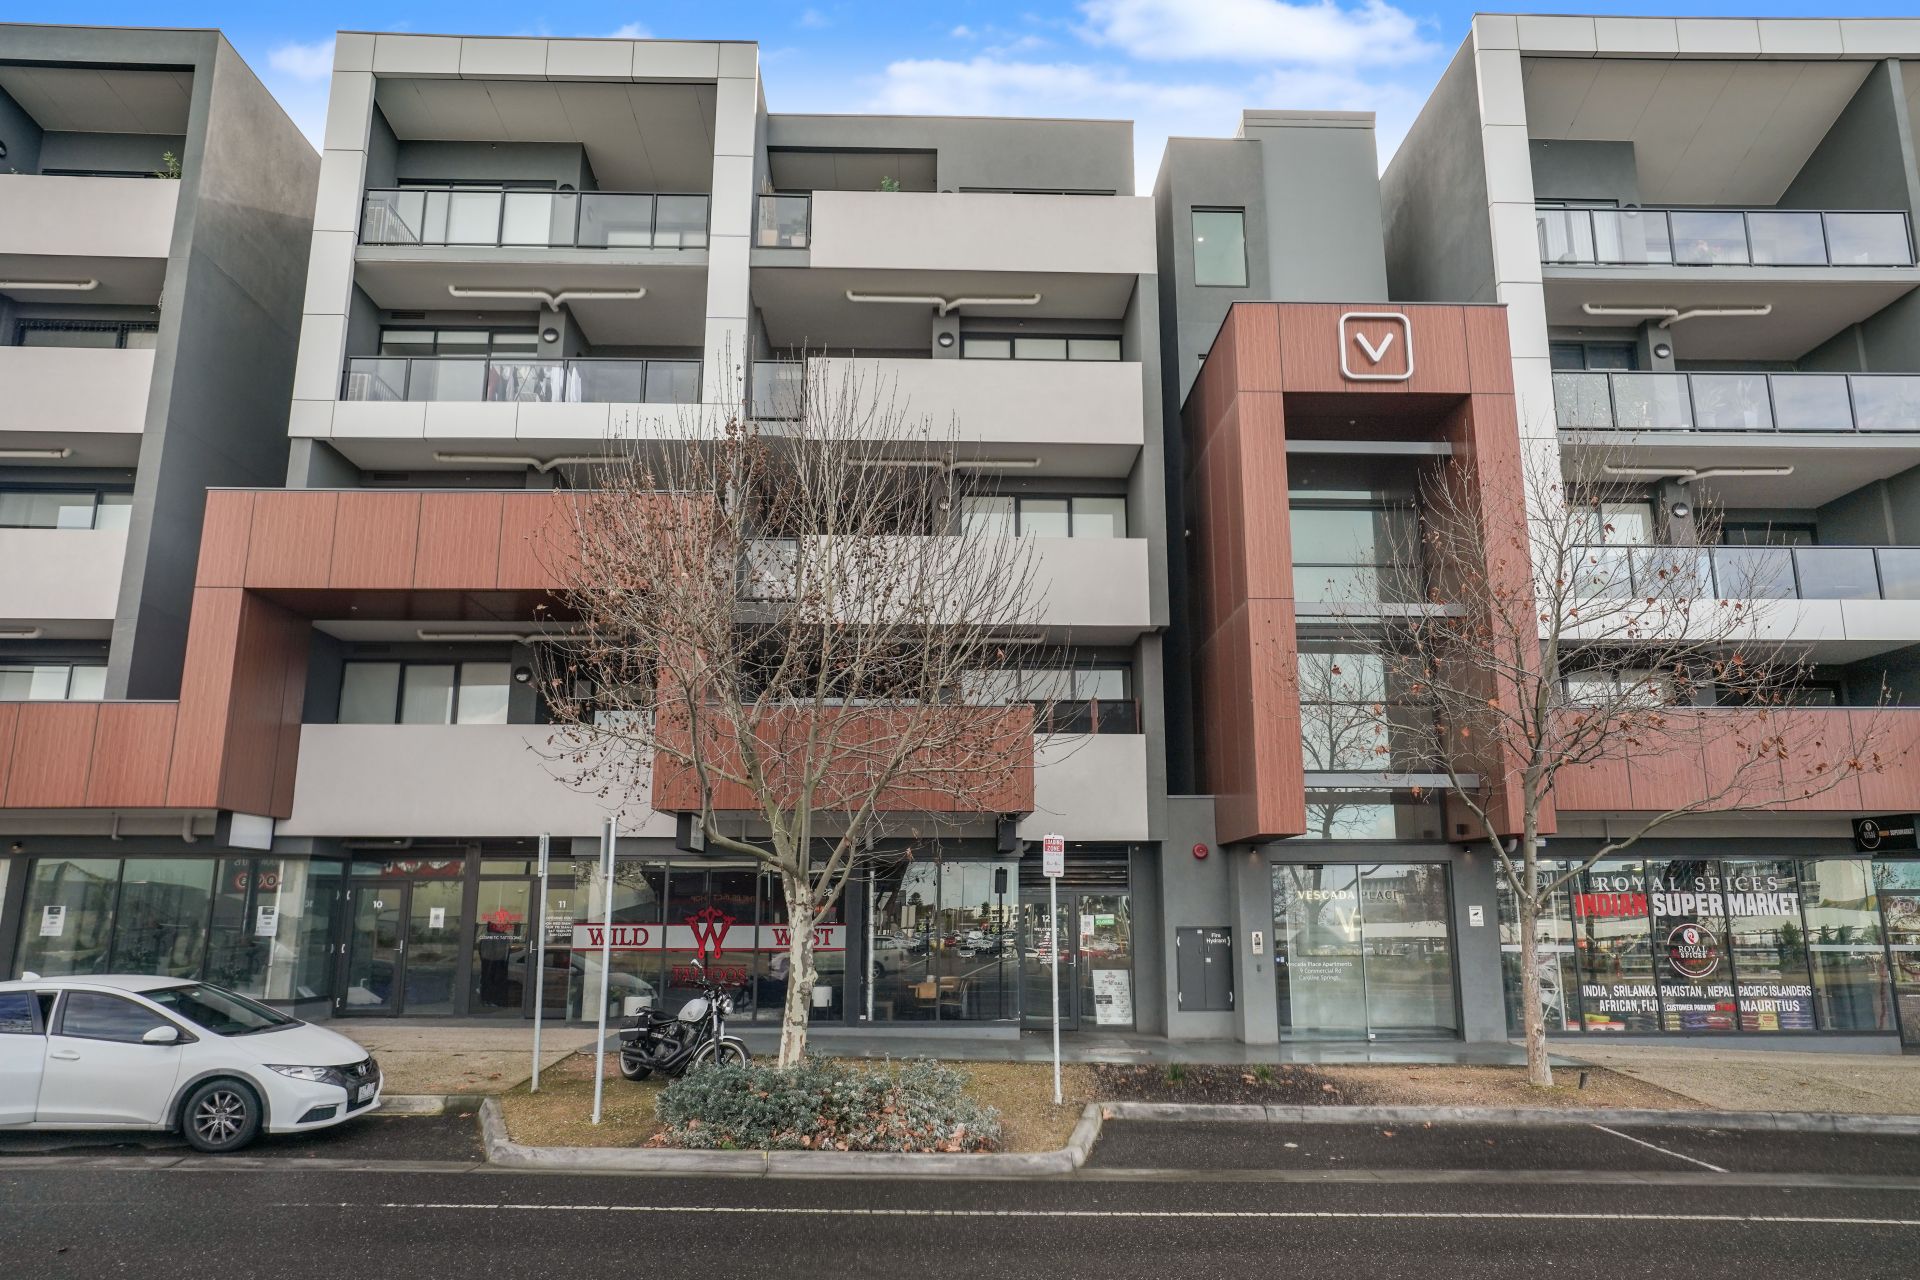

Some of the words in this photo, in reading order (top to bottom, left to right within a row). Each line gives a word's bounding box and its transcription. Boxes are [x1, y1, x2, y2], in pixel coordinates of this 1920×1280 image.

[1598, 877, 1681, 892] ROYAL
[1695, 876, 1778, 892] SPICES
[1297, 890, 1355, 900] VESCADA
[373, 900, 383, 909] 10
[558, 900, 567, 909] 11
[1574, 893, 1648, 917] INDIAN
[1041, 914, 1051, 923] 12
[587, 928, 649, 946] WILD
[772, 928, 834, 946] WST
[1678, 945, 1706, 953] ROYAL
[1613, 985, 1658, 997] SRILANKA
[1661, 985, 1702, 997] PAKISTAN
[1707, 985, 1735, 997] NEPAL
[1738, 985, 1768, 997] PACIFIC
[1769, 985, 1812, 997] ISLANDERS
[1641, 999, 1659, 1012] FIJI
[1740, 1000, 1801, 1012] MAURITIUS
